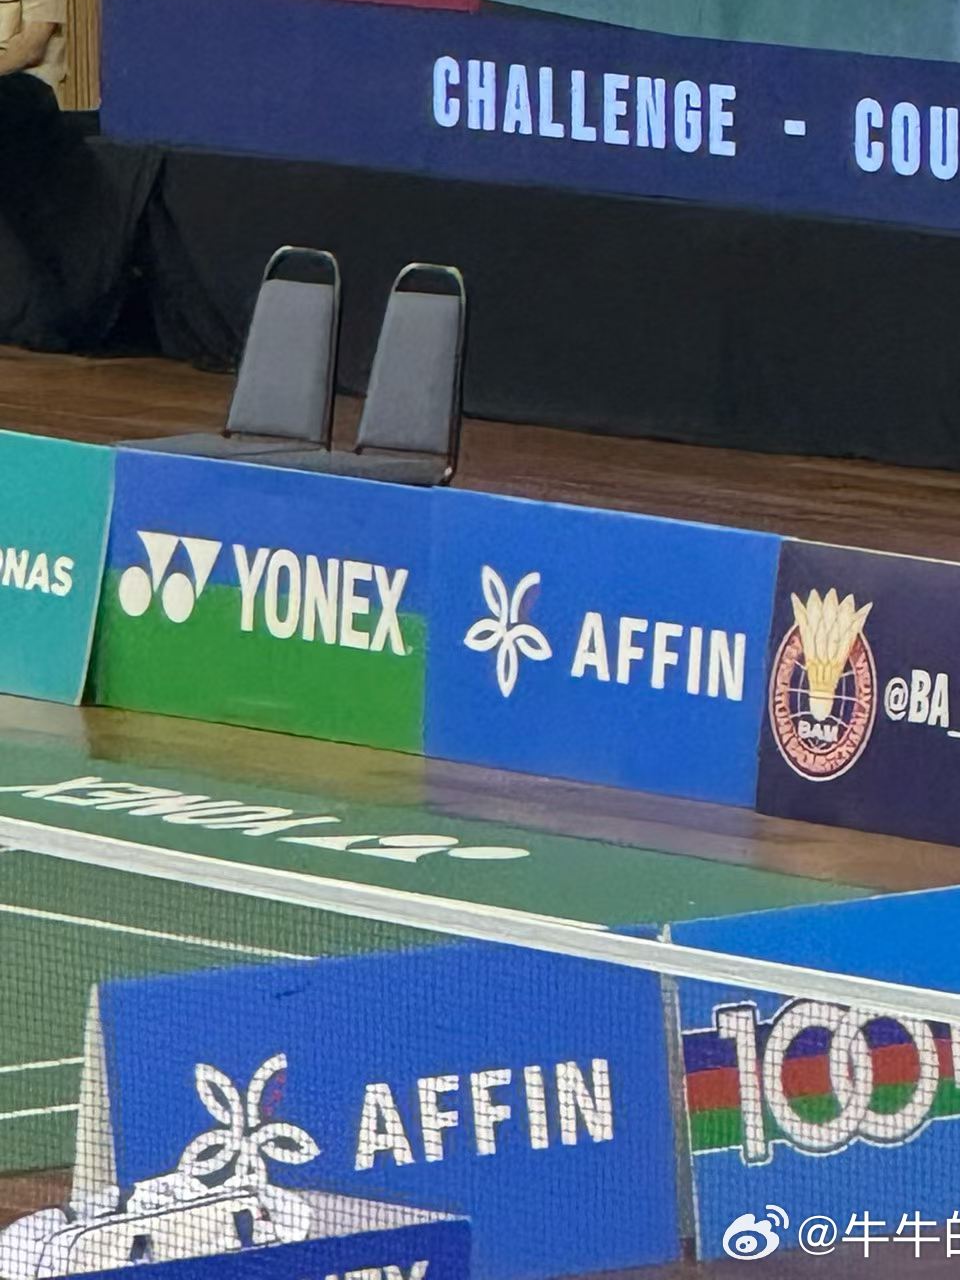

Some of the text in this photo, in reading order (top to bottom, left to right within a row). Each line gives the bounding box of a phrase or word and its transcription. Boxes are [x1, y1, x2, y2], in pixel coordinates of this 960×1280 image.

[432, 56, 737, 157] CHALLENGE
[0, 547, 74, 597] NAS
[233, 544, 412, 656] YONEX
[571, 611, 746, 702] AFFIN
[0, 776, 341, 836] YONEX
[354, 1058, 614, 1171] AFFIN
[718, 998, 939, 1162] 100
